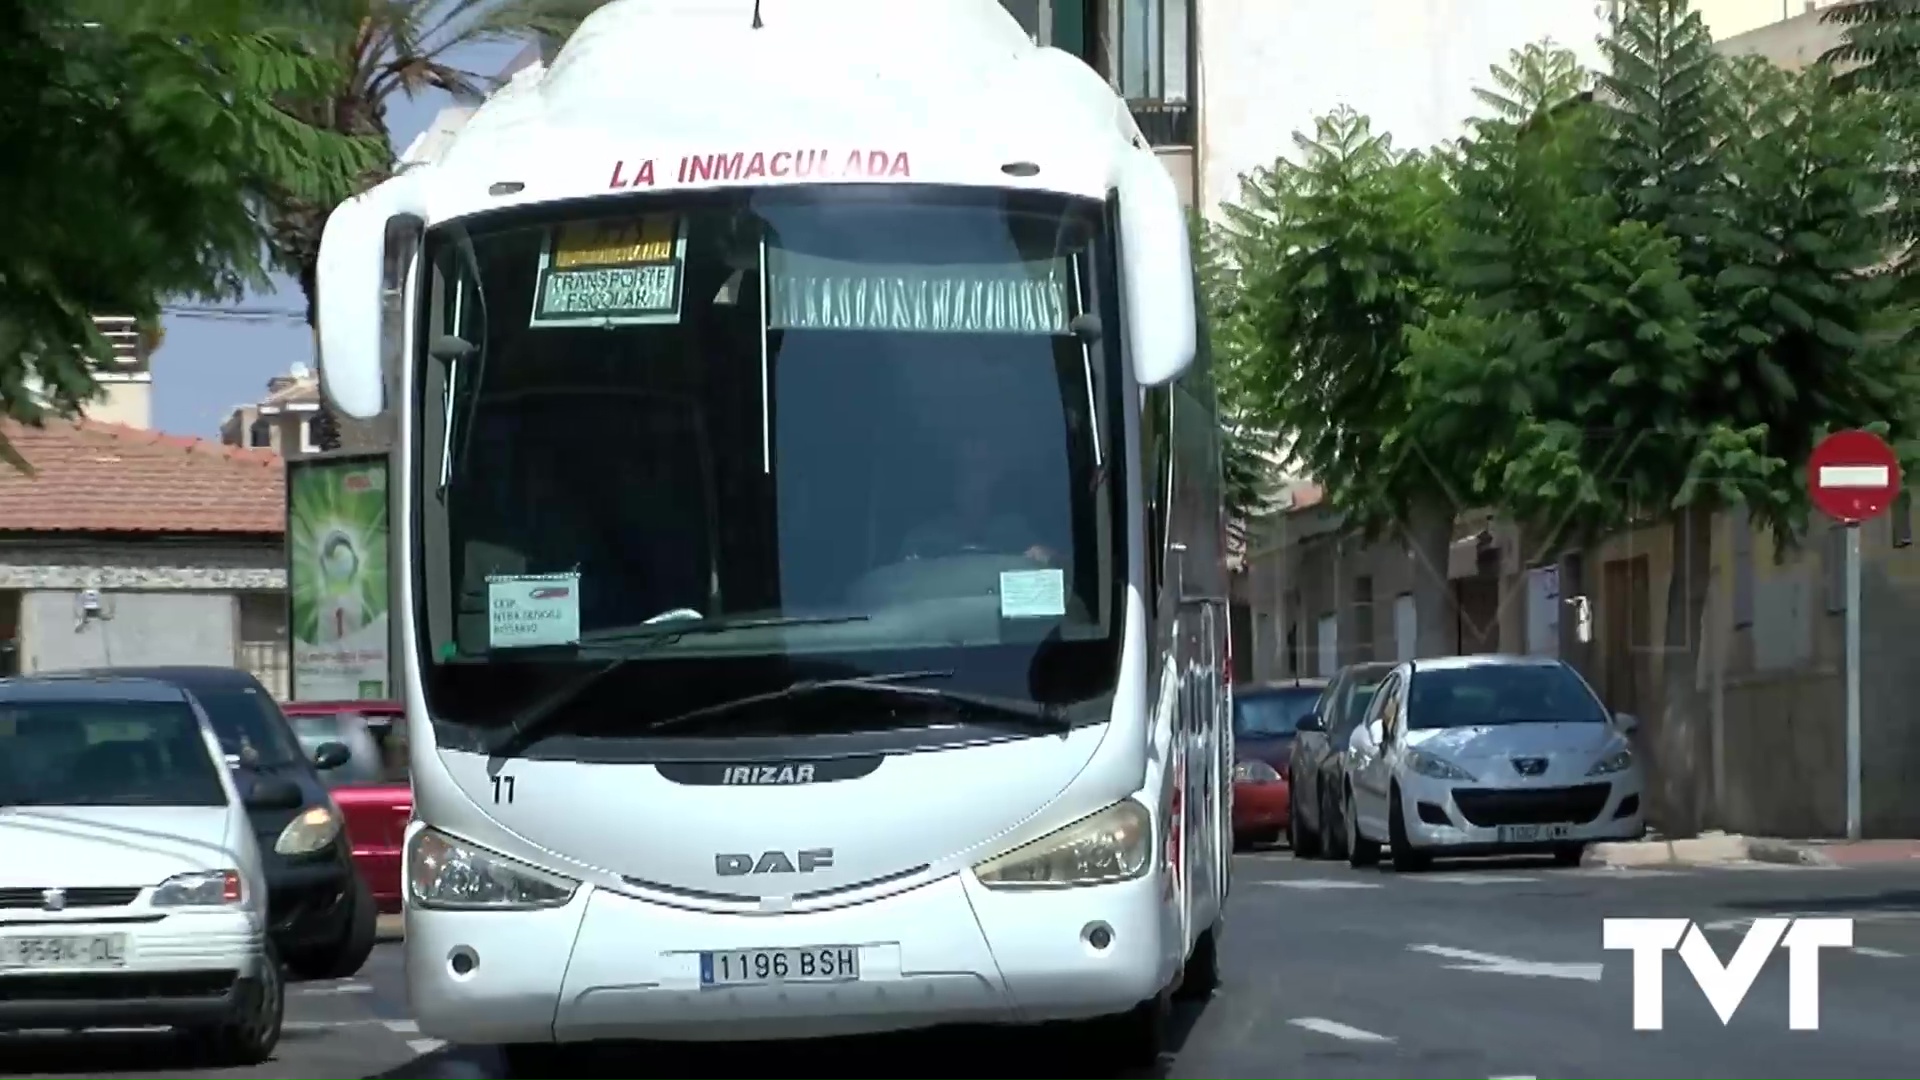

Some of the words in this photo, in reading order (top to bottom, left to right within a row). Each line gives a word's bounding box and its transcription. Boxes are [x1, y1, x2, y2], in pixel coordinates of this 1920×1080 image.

[609, 159, 655, 189] LA
[677, 149, 911, 183] INMACULADA
[553, 268, 666, 292] TRANSPORTE
[722, 764, 816, 785] IRIZAR
[715, 848, 834, 875] DAF
[721, 953, 788, 980] 1196
[800, 949, 853, 976] BSH
